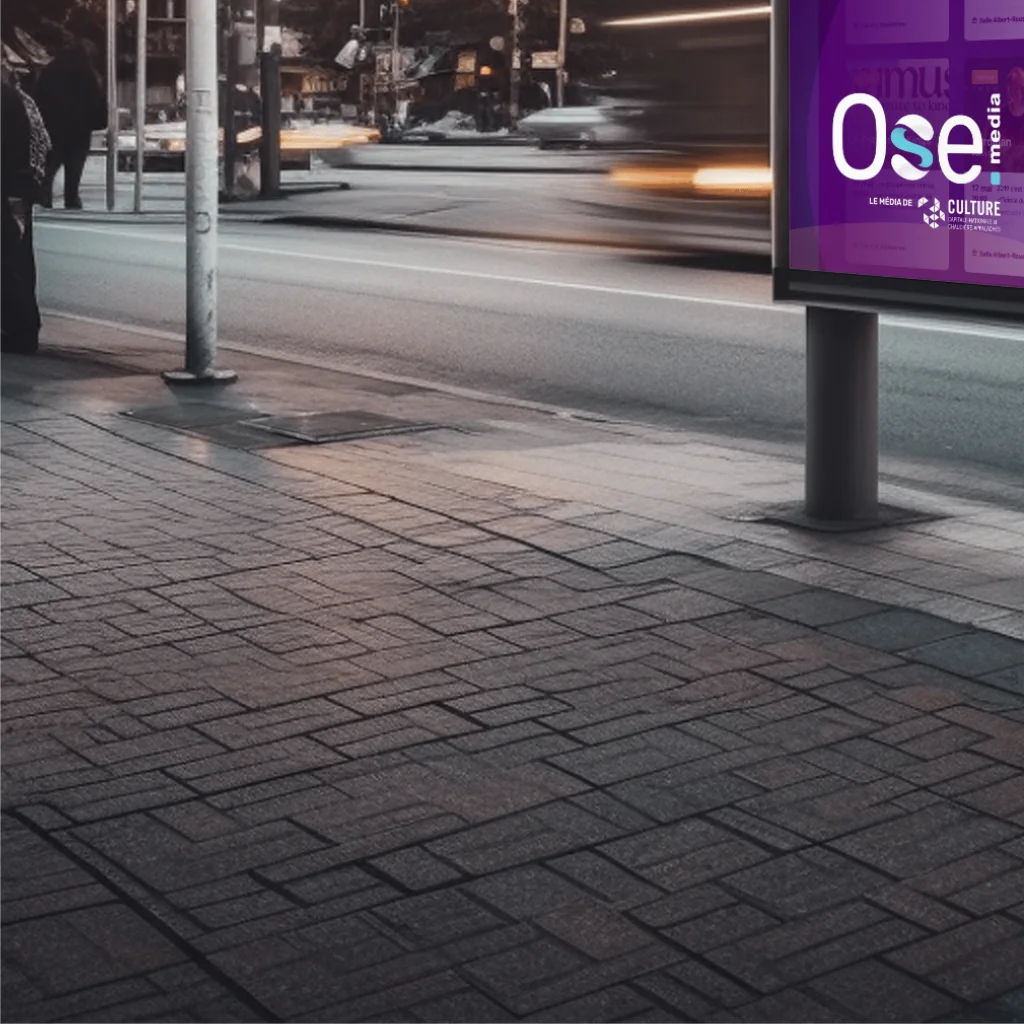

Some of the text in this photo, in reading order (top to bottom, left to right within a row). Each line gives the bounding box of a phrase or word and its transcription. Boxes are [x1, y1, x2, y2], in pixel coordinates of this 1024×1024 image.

[869, 196, 913, 207] LE MÉDIA DE
[947, 199, 1001, 217] CULTURE
